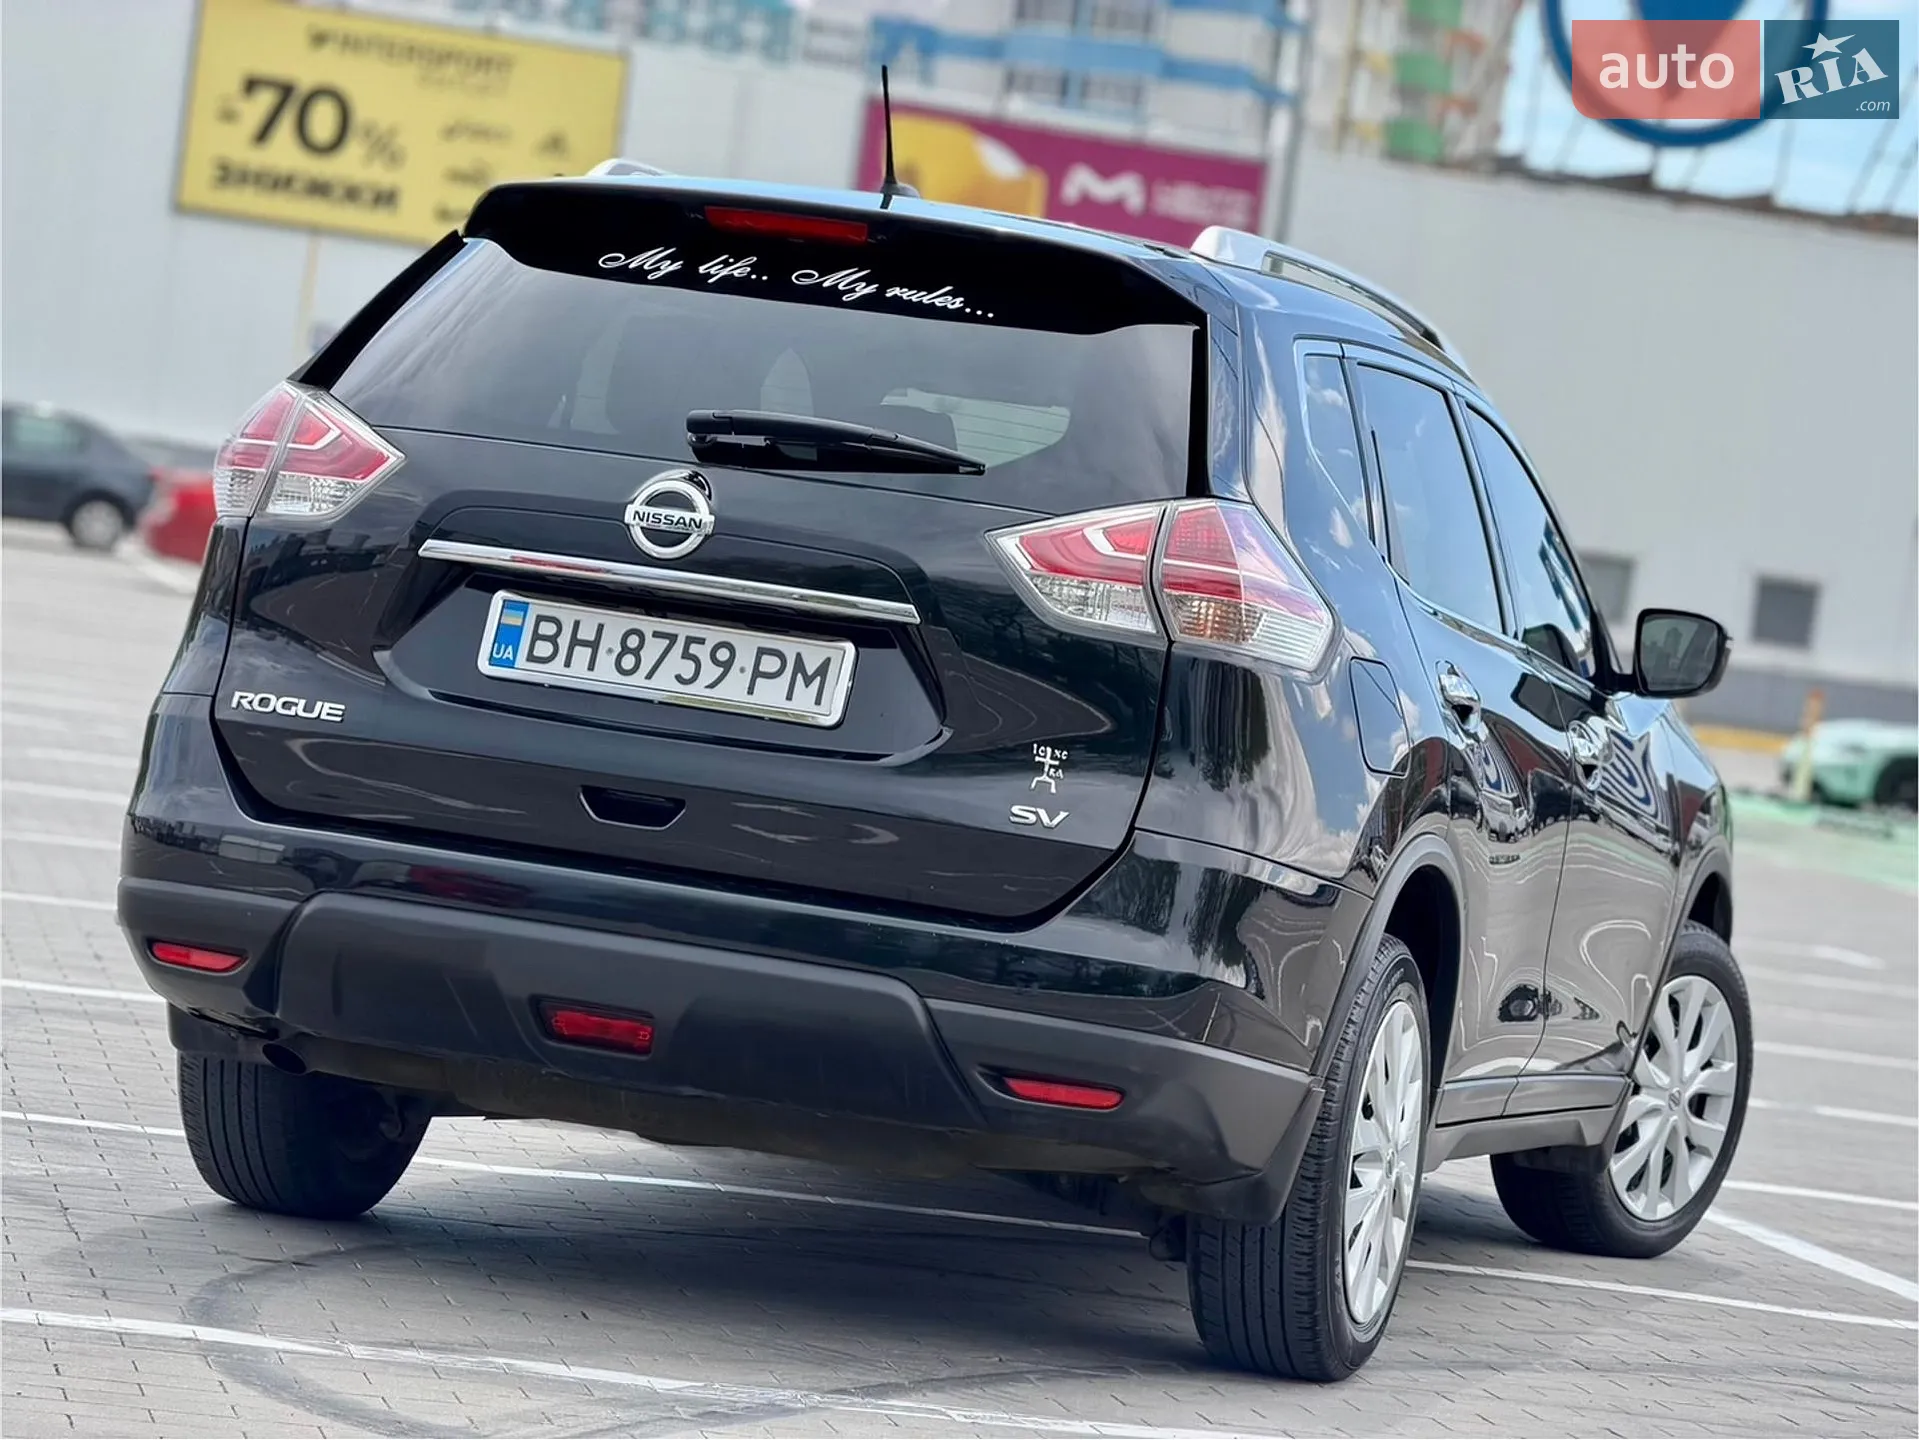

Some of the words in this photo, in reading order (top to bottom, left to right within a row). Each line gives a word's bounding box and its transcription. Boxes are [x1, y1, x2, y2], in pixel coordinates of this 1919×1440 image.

[599, 247, 683, 280] My
[699, 255, 769, 284] life..
[792, 268, 876, 301] My
[886, 285, 995, 319] rules...
[632, 510, 703, 529] NISSAN
[493, 644, 514, 661] UA
[613, 628, 737, 690] 8759
[746, 646, 833, 706] PM
[231, 691, 346, 722] ROGUE
[1009, 805, 1070, 829] SV
